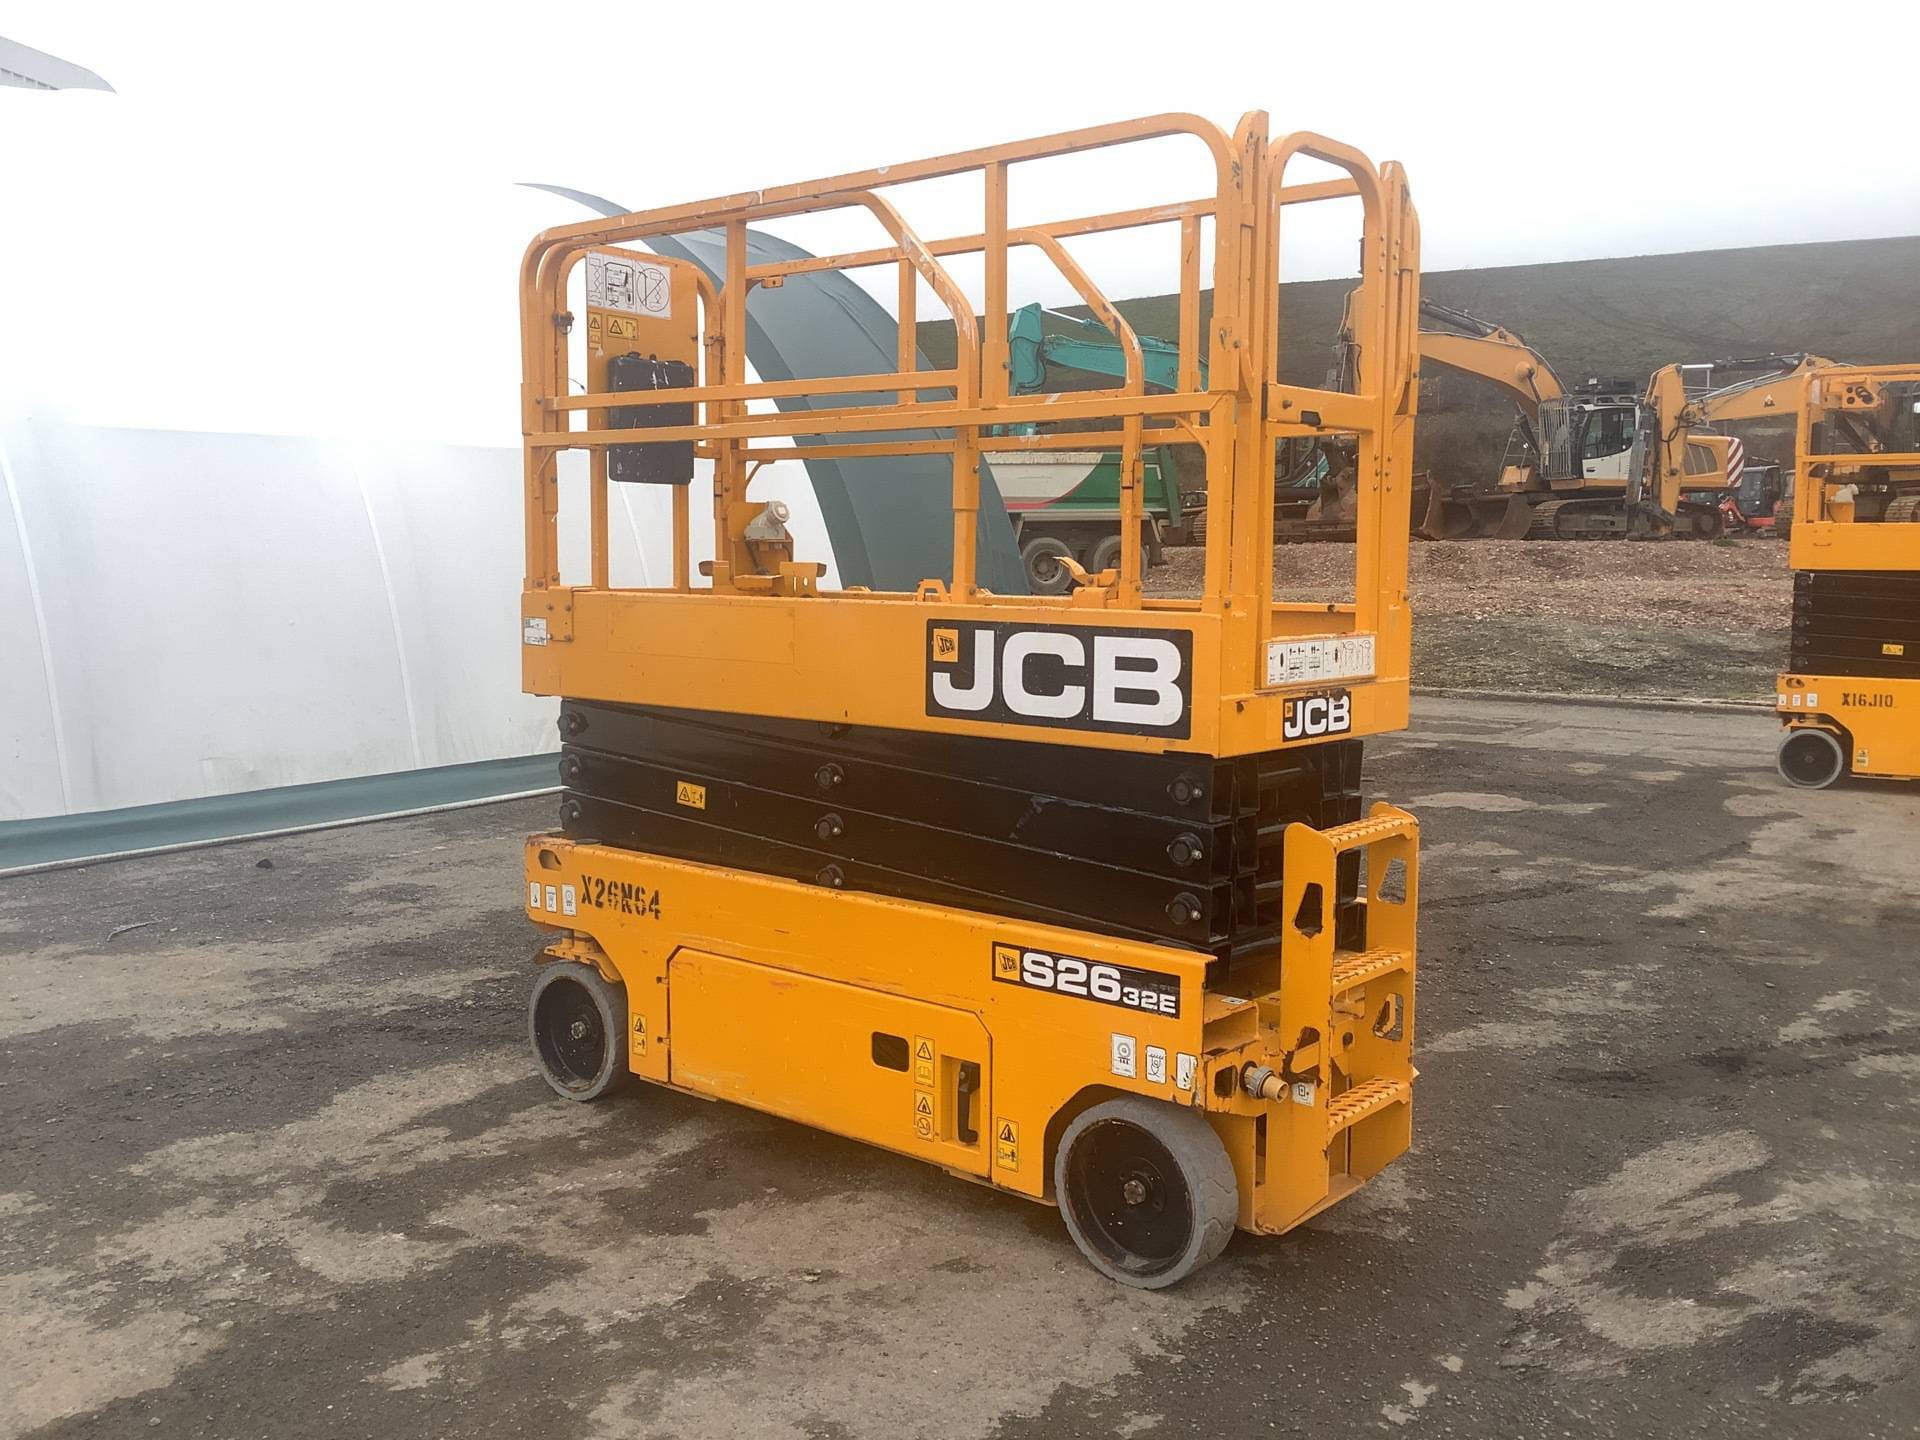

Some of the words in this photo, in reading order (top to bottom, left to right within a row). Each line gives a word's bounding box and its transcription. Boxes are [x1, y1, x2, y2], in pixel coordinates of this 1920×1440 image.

[933, 629, 1183, 726] JCB
[1284, 695, 1350, 738] JCB
[581, 874, 661, 920] X26N64
